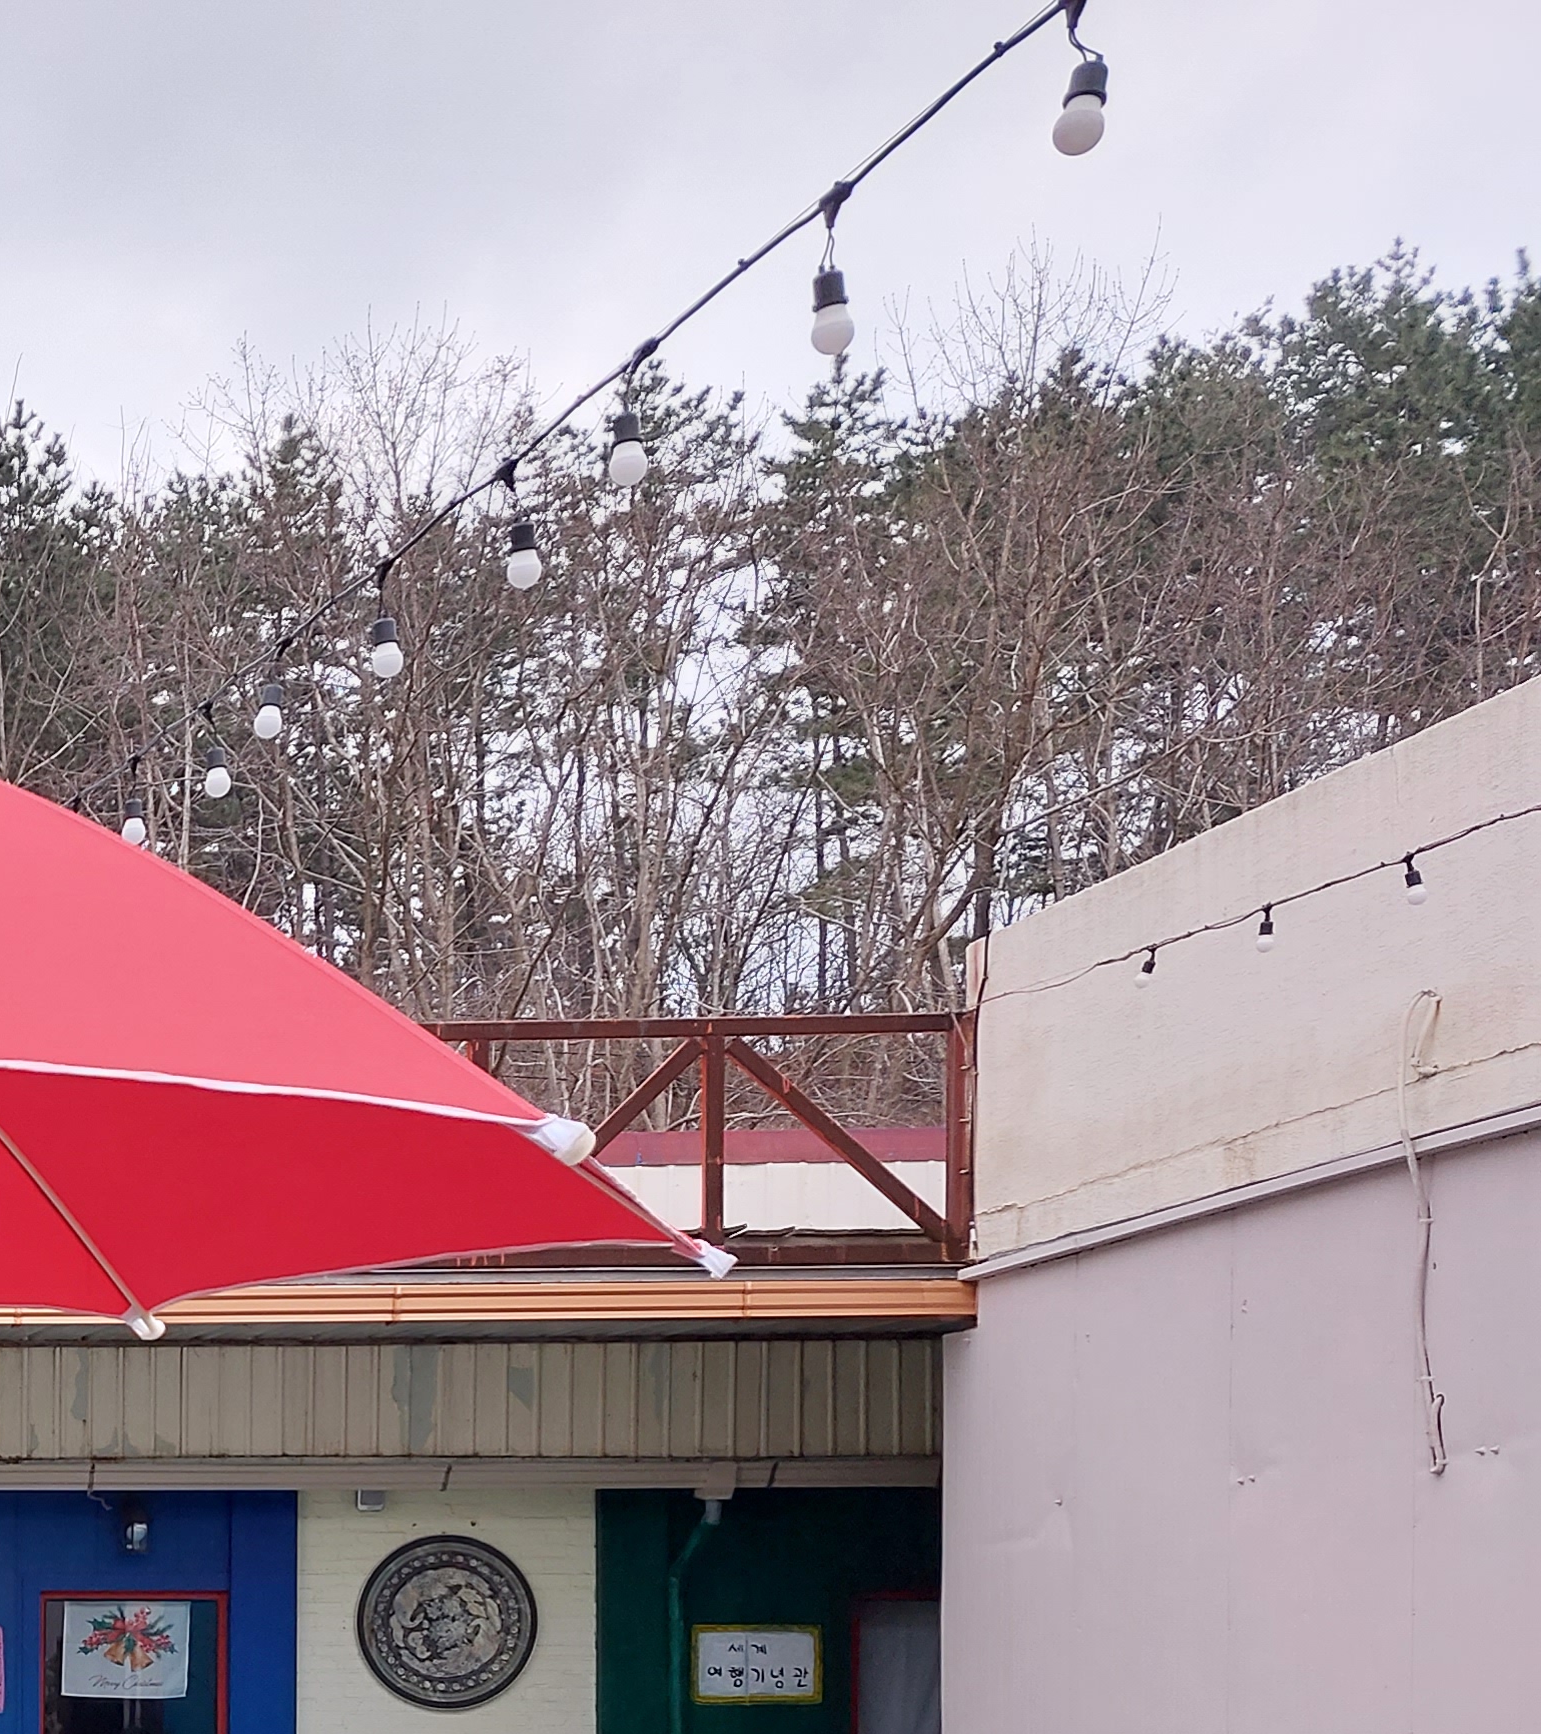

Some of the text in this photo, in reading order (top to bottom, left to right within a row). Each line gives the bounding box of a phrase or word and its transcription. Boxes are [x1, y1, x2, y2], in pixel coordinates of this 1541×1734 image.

[727, 1643, 768, 1655] 세계
[88, 1675, 121, 1690] Merry
[707, 1666, 809, 1689] 여행기념관
